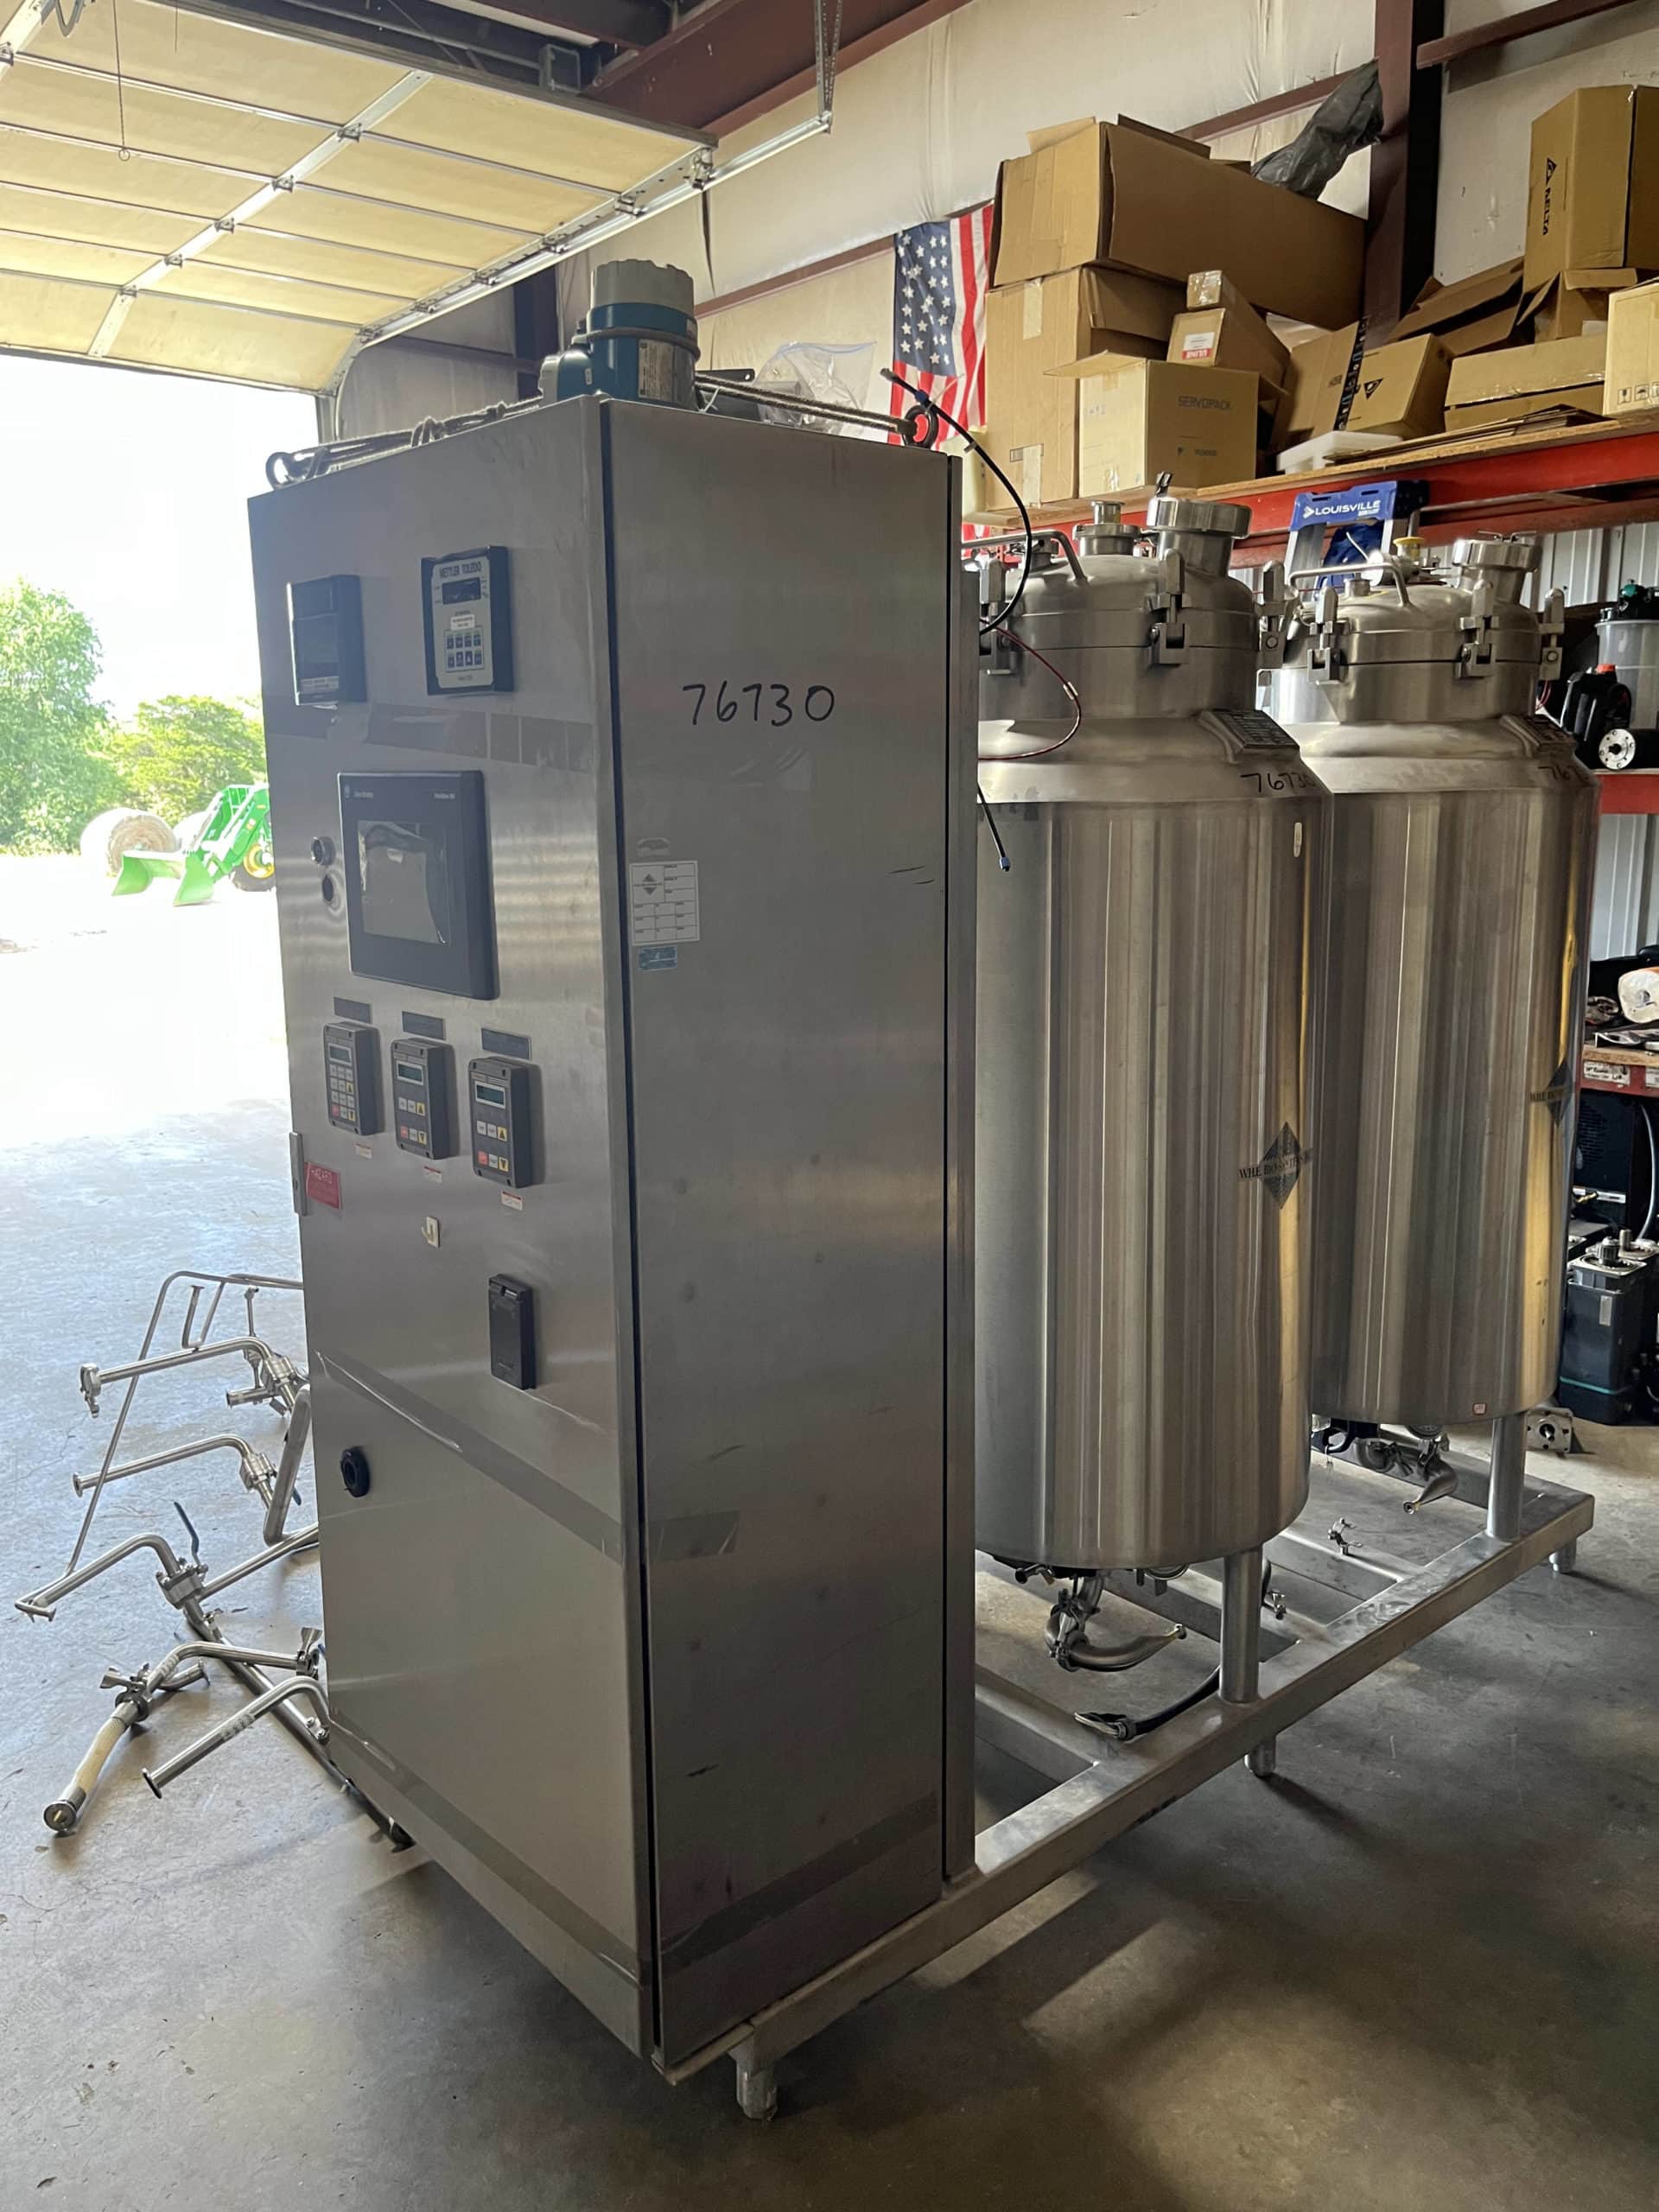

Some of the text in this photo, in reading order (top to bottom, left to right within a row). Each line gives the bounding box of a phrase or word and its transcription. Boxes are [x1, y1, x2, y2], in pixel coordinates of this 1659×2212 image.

[1178, 395, 1231, 410] SERVOPACK
[1315, 500, 1381, 516] LOUISVILLE
[683, 680, 835, 727] 76730
